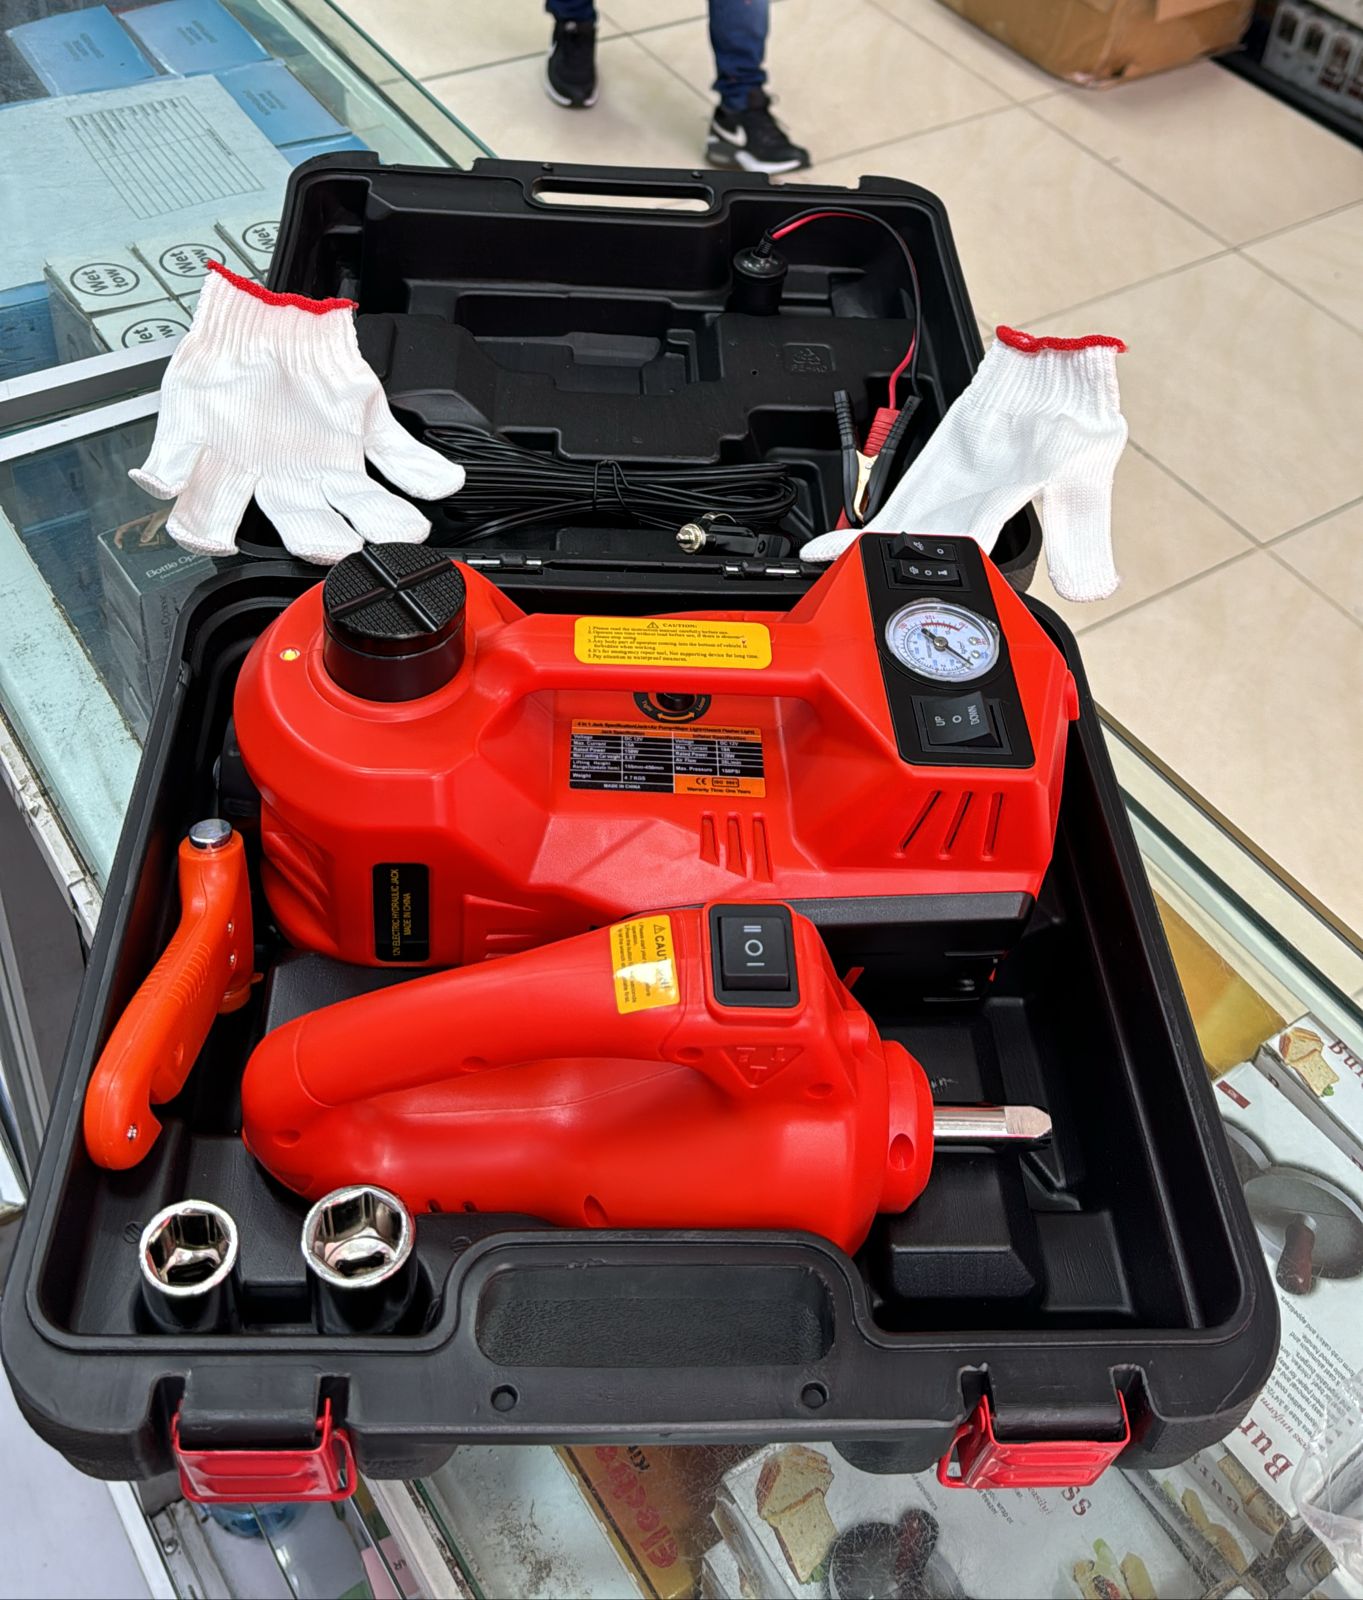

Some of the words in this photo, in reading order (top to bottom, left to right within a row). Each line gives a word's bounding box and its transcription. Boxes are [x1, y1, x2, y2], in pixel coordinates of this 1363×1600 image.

[168, 250, 197, 274] Wet
[191, 248, 210, 268] ow
[80, 268, 110, 292] Wet
[104, 268, 128, 288] tow
[132, 326, 156, 344] et
[146, 562, 177, 578] Bottle
[935, 716, 946, 727] UP
[967, 704, 980, 726] DOWN
[390, 869, 399, 885] JACK
[391, 886, 400, 918] HYDRAULIC
[403, 892, 411, 911] CHINA
[392, 919, 400, 946] ELECTRIC
[403, 920, 411, 935] MADE
[1289, 1331, 1301, 1343] and
[1305, 1323, 1316, 1334] and
[1302, 1334, 1320, 1354] handle.
[1275, 1356, 1290, 1370] easy
[1296, 1351, 1316, 1374] burgers.
[1318, 1352, 1334, 1368] wood
[1331, 1350, 1343, 1363] crab
[1280, 1371, 1291, 1382] and
[1291, 1357, 1311, 1379] chicken,
[1323, 1368, 1336, 1381] cast
[1342, 1362, 1355, 1377] form
[1289, 1382, 1311, 1404] removal
[1296, 1378, 1313, 1394] paper
[1311, 1378, 1325, 1395] beef,
[1315, 1373, 1340, 1401] vegetable
[1287, 1393, 1306, 1413] patties
[1260, 1397, 1293, 1432] uniform
[1288, 1410, 1302, 1426] base
